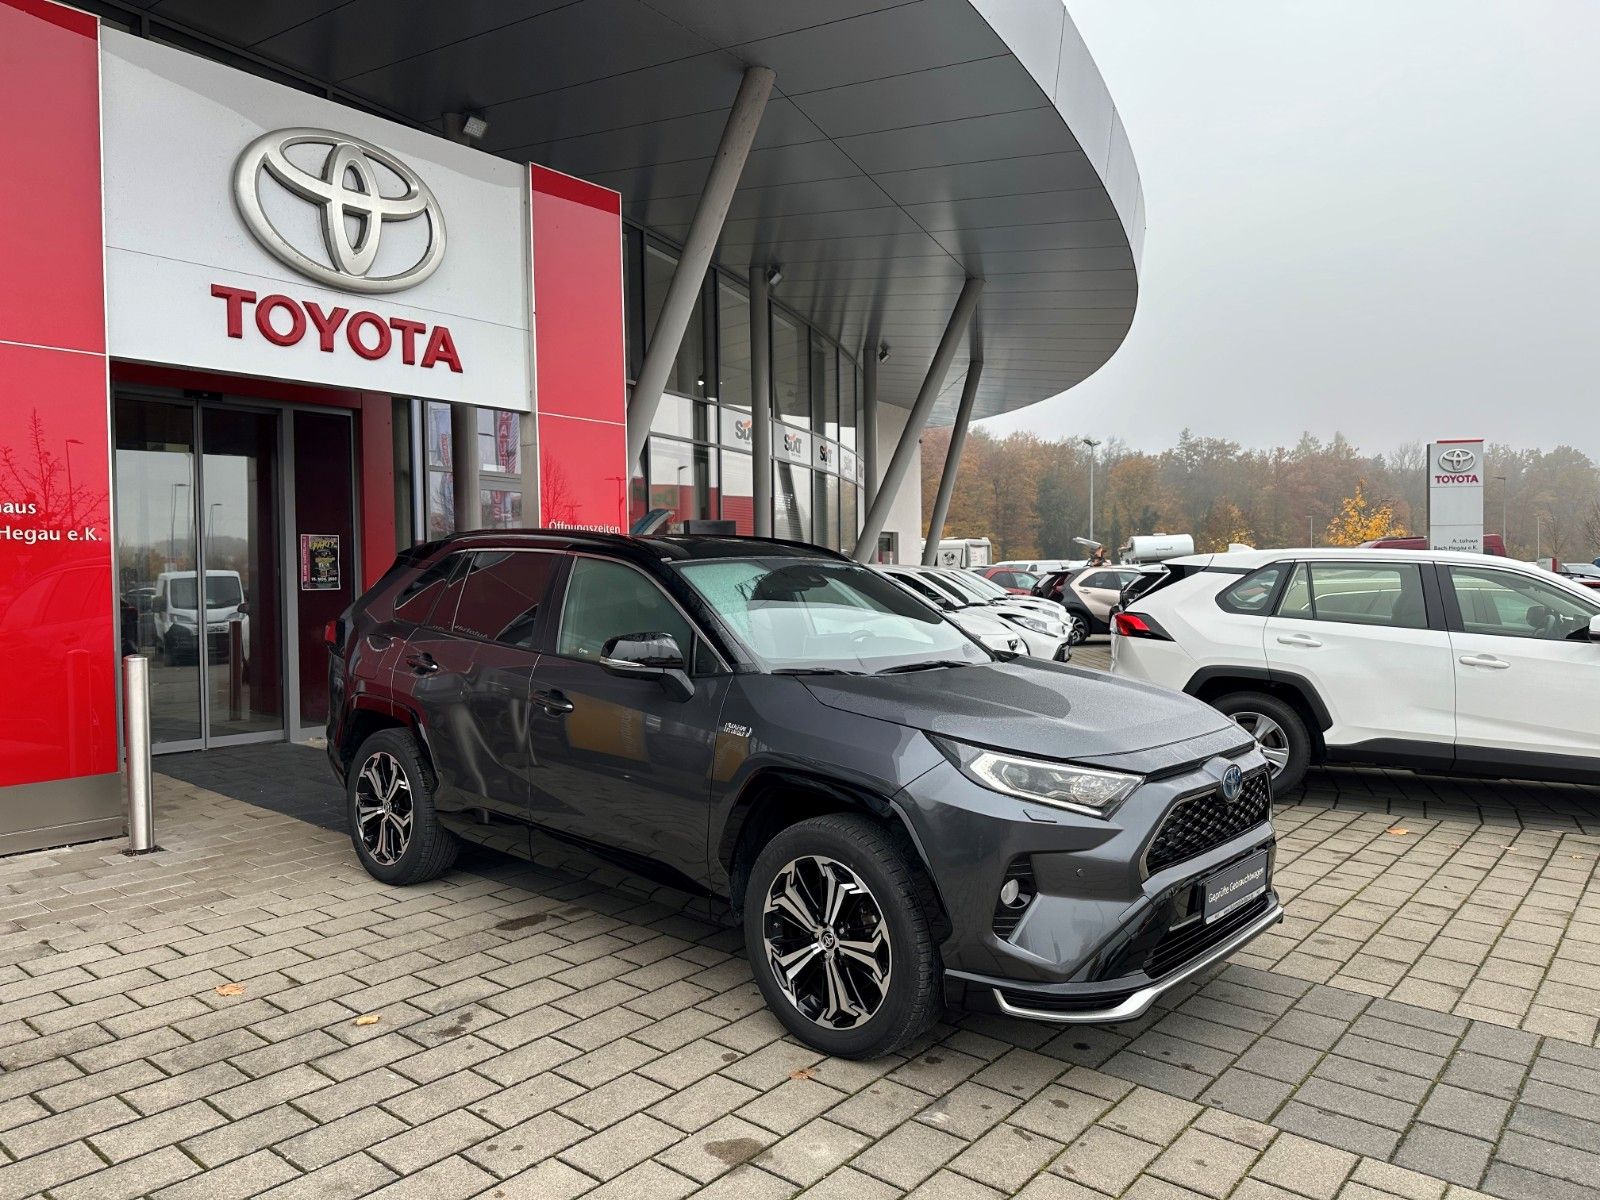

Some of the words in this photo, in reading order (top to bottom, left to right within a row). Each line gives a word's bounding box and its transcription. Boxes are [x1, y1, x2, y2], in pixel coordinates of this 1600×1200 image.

[211, 283, 464, 374] TOYOTA
[1435, 474, 1478, 484] TOYOTA
[0, 502, 36, 514] aus
[0, 525, 60, 544] Hegau
[67, 526, 102, 541] e.K.
